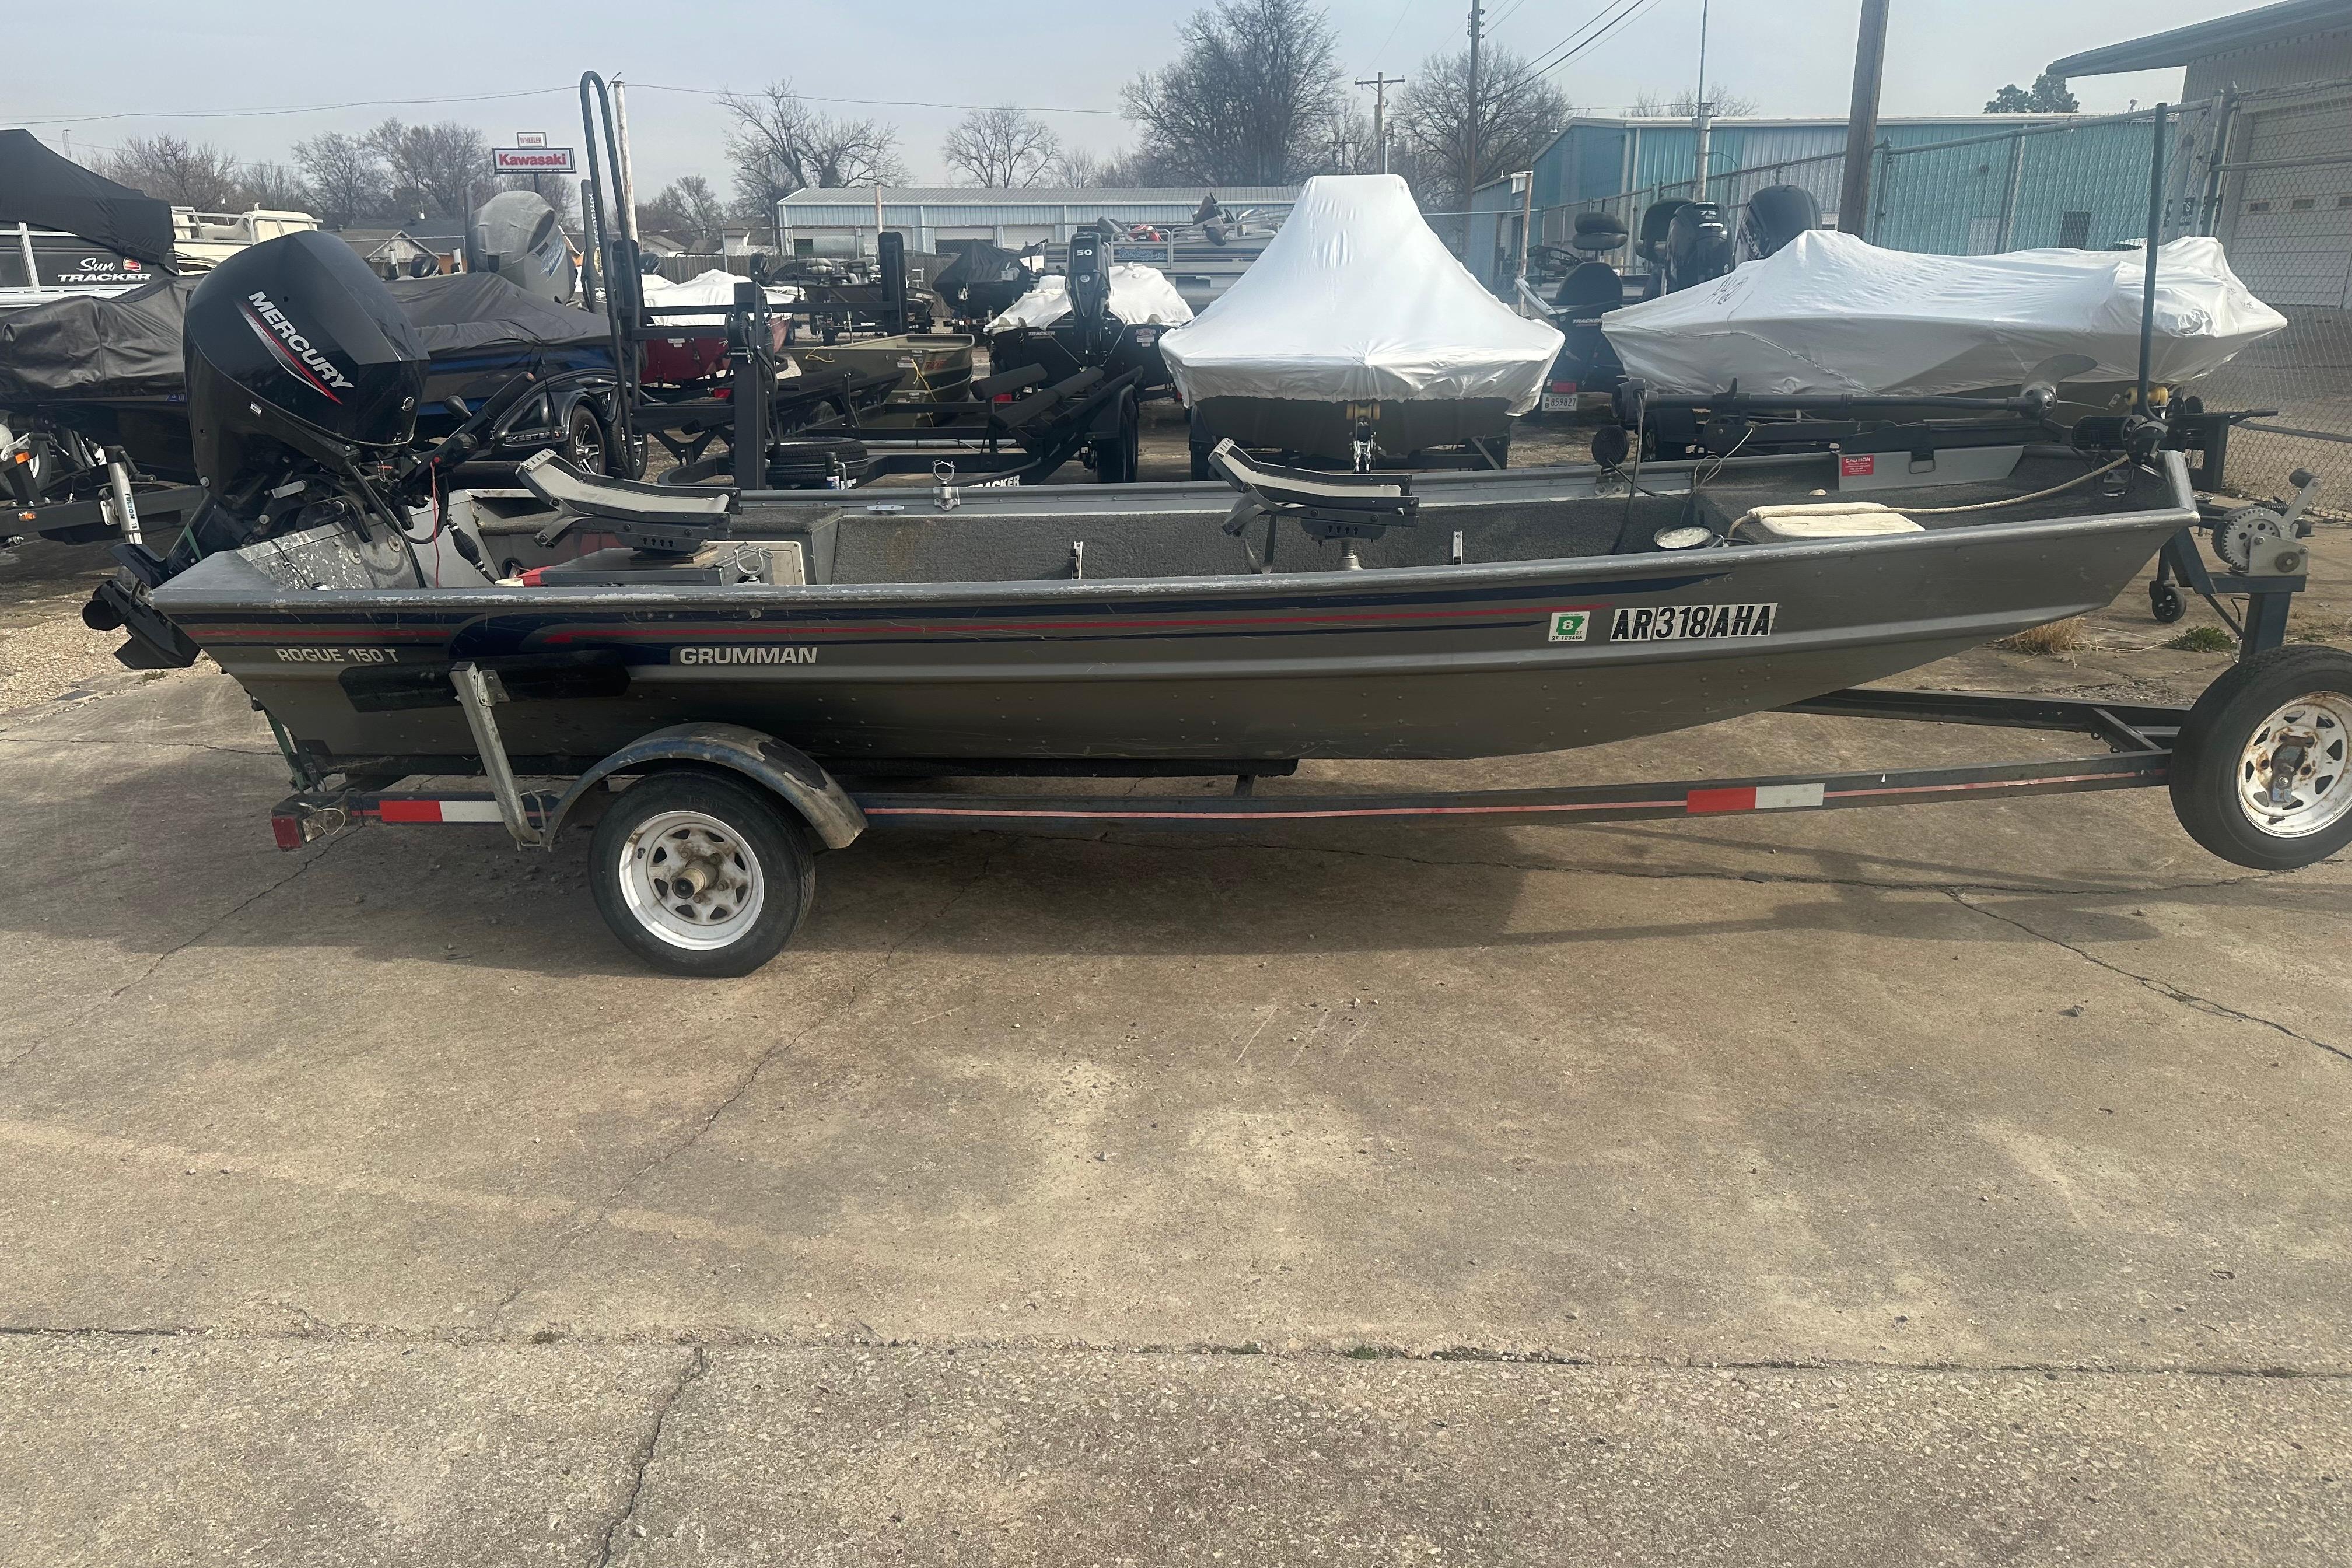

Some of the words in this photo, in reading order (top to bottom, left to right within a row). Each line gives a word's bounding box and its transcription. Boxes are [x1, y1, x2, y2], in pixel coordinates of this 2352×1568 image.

[499, 153, 566, 166] Kawasaki
[76, 257, 116, 271] Sun
[57, 273, 151, 282] TRACKER
[248, 291, 355, 388] MERCURY
[1550, 398, 1577, 407] 859827
[1562, 620, 1573, 630] 8
[274, 648, 345, 662] ROGUE
[348, 649, 385, 662] 150
[384, 649, 399, 662] T
[680, 647, 817, 664] GRUMMAN
